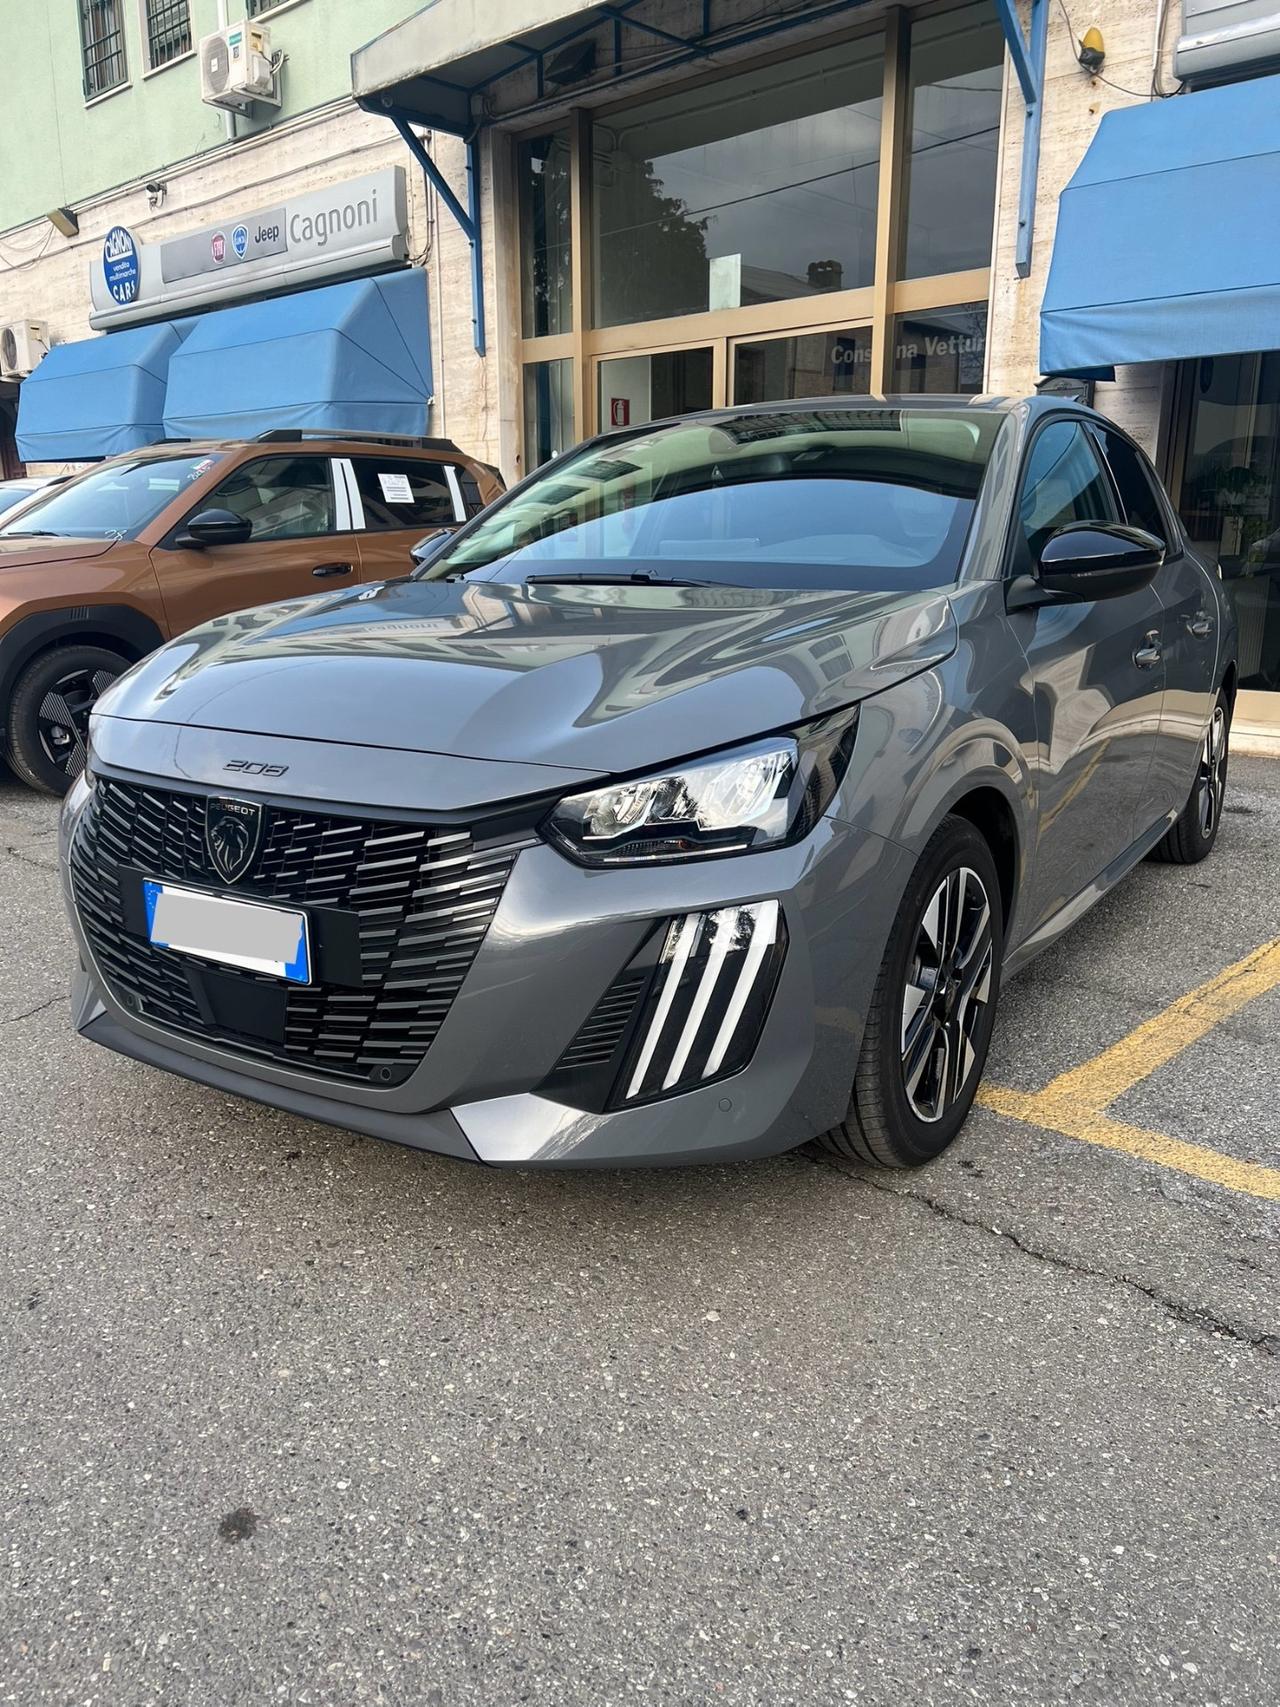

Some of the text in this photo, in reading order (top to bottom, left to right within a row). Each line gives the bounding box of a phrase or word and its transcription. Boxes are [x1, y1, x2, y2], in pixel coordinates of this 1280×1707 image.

[290, 189, 378, 246] Cagnoni
[254, 225, 279, 243] Jeep
[105, 229, 133, 262] CAGNONI
[112, 280, 135, 301] CARS
[831, 335, 985, 364] Consna Vettur
[222, 760, 289, 777] 208
[209, 803, 255, 816] PEUGEOT
